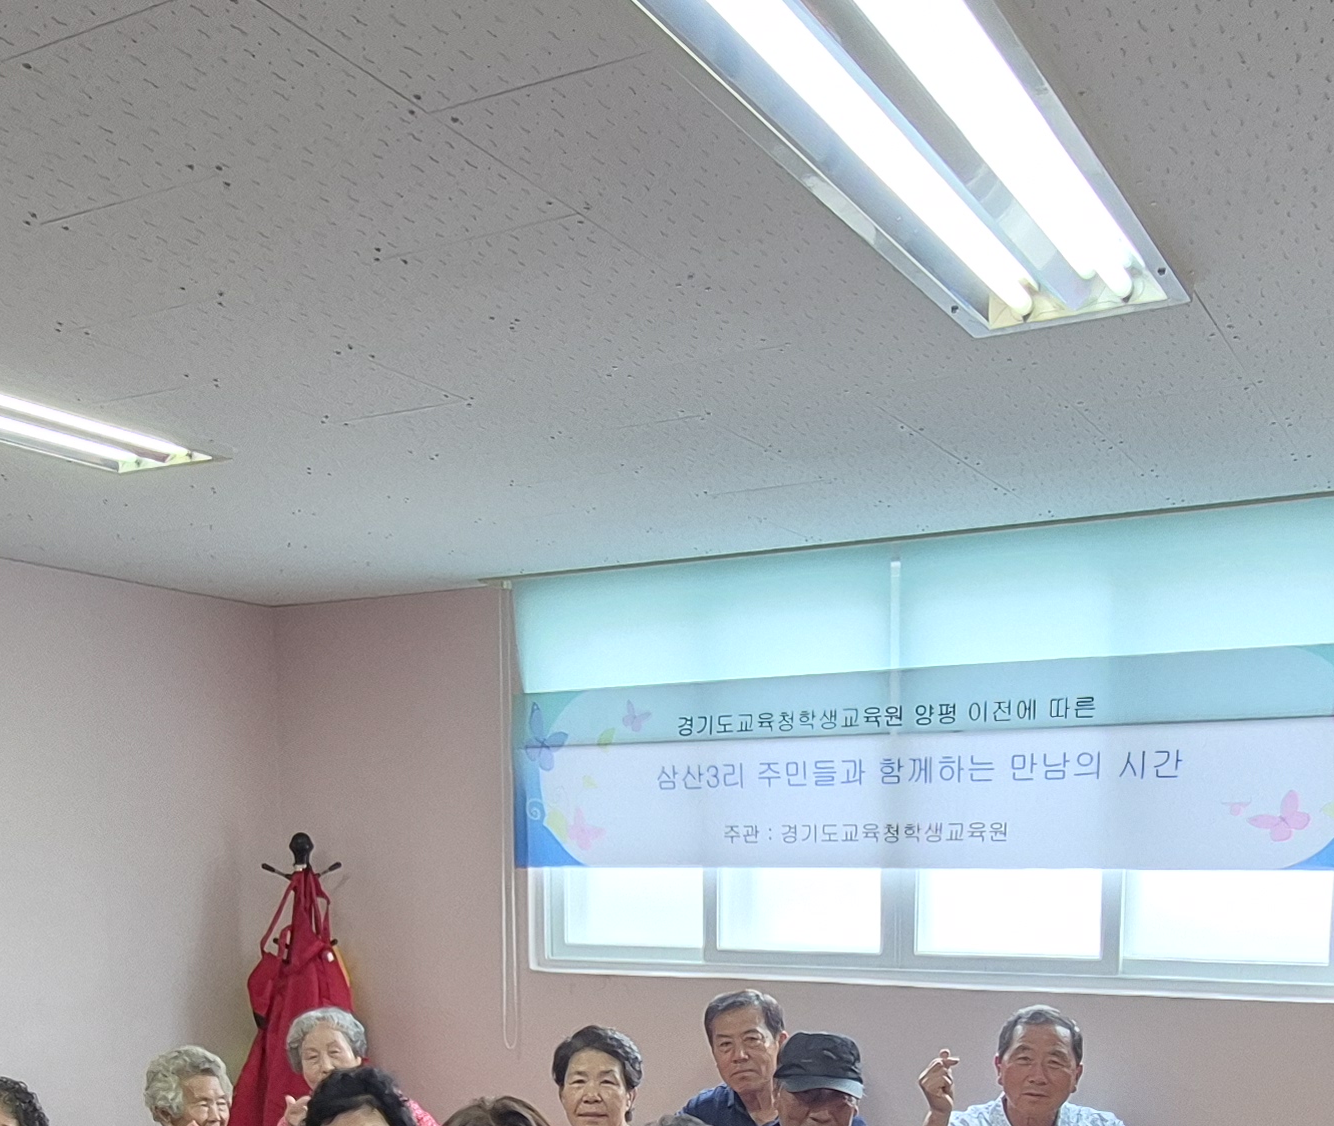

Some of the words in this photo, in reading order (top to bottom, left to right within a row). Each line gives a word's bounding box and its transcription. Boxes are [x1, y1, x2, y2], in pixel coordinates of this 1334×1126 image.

[676, 703, 904, 737] 경기도교육청학생교육원
[913, 701, 958, 727] 양평
[967, 698, 1038, 724] 이전에
[1048, 695, 1097, 721] 따른
[656, 762, 745, 792] 삼산3리
[757, 757, 867, 789] 주민들과
[878, 753, 996, 786] 함께하는
[1009, 750, 1103, 783] 만남의
[1118, 748, 1184, 781] 시간
[723, 823, 760, 845] 주관
[780, 821, 1009, 844] 경기도교육청학생교육원
